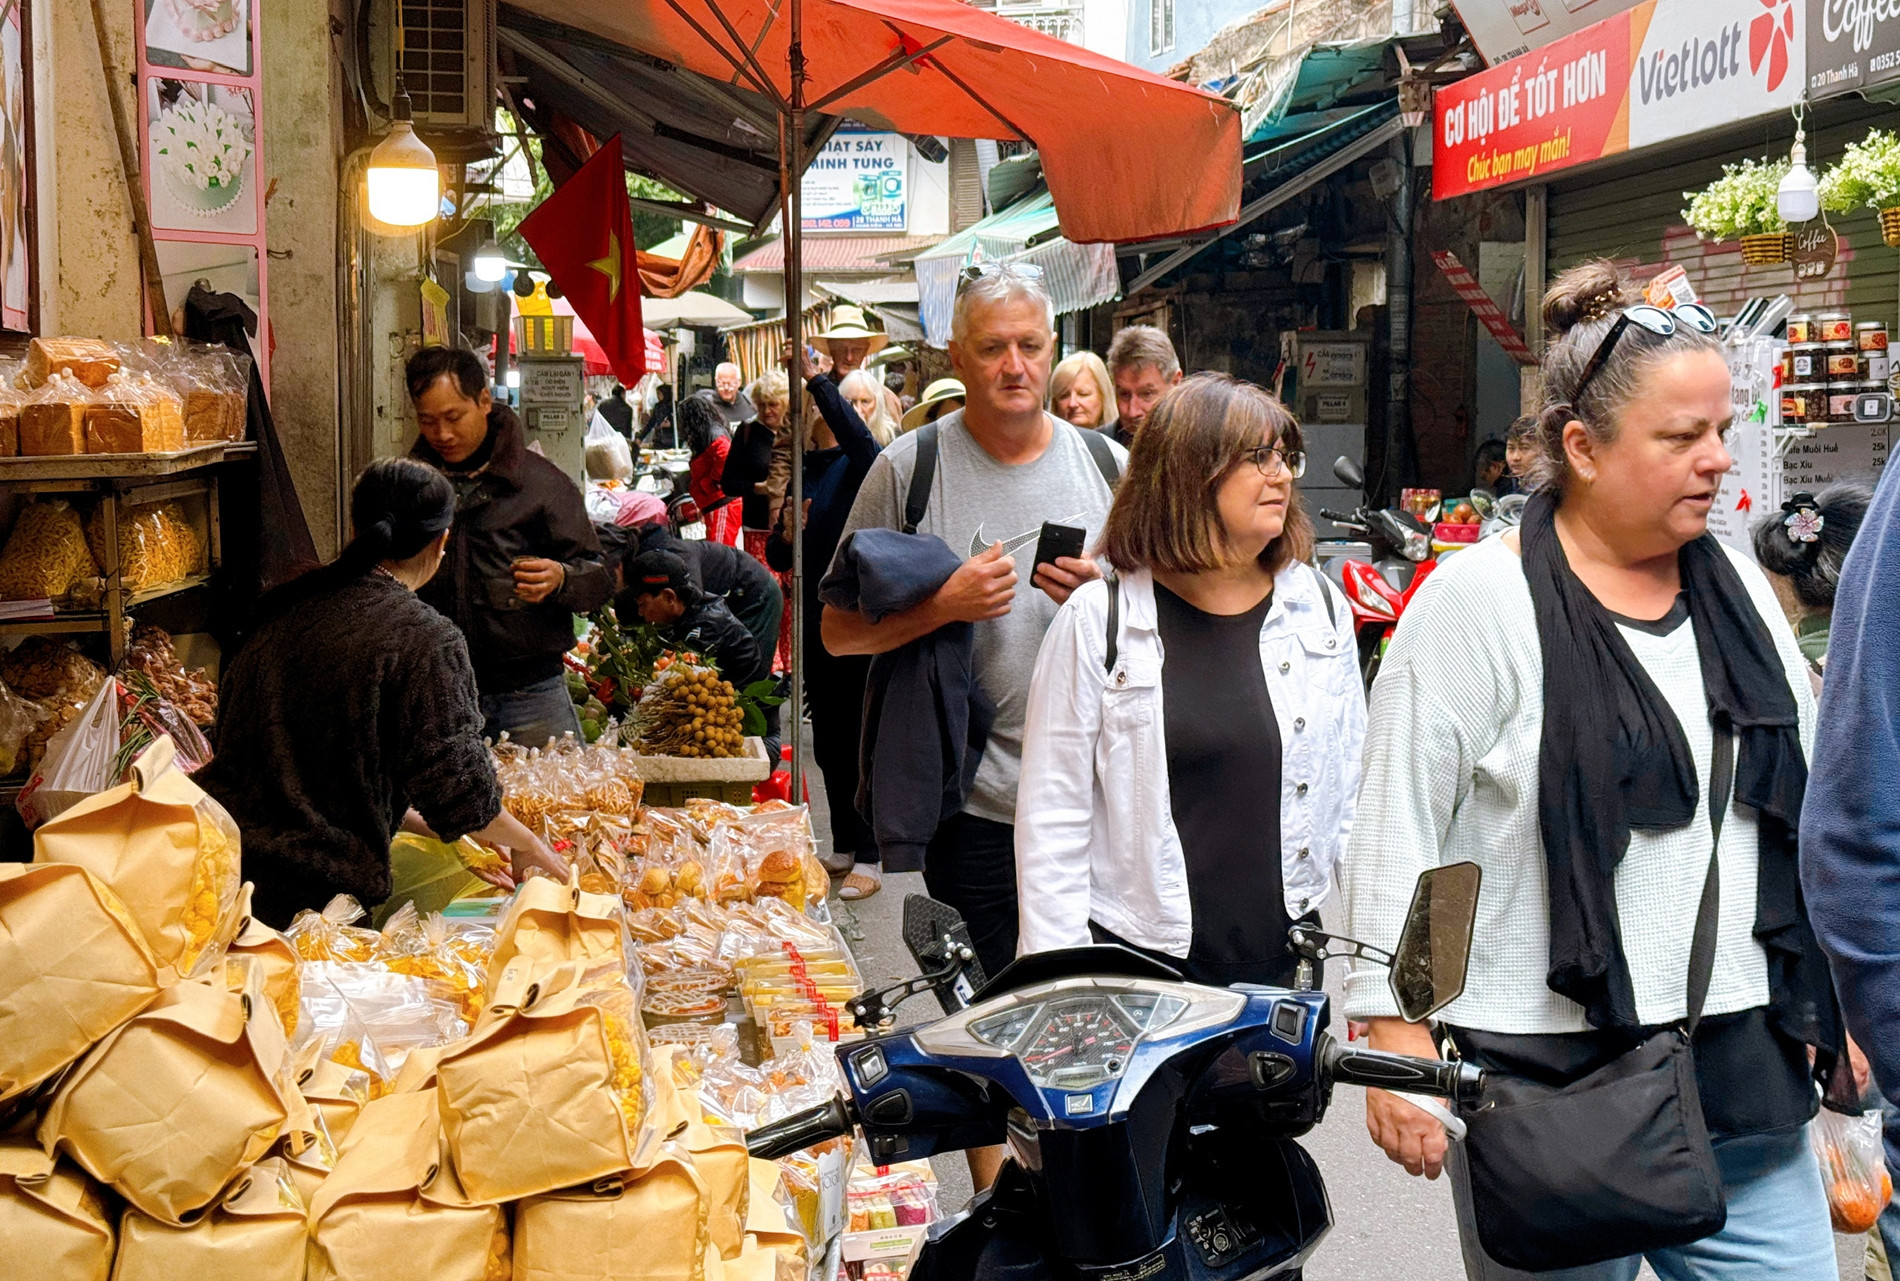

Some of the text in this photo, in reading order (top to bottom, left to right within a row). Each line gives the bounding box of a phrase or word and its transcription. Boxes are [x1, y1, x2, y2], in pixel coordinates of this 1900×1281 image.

[1639, 20, 1742, 106] Vietlott
[1876, 52, 1895, 71] 0352
[1817, 62, 1858, 87] 20 Thanh Hà
[1444, 49, 1606, 148] CƠ HỘI ĐỂ TỐT HƠN
[853, 155, 894, 169] TÙNG
[1467, 126, 1571, 183] Chúc bạn may mắn!
[1783, 461, 1798, 471] Bạc
[1783, 475, 1798, 486] Bạc
